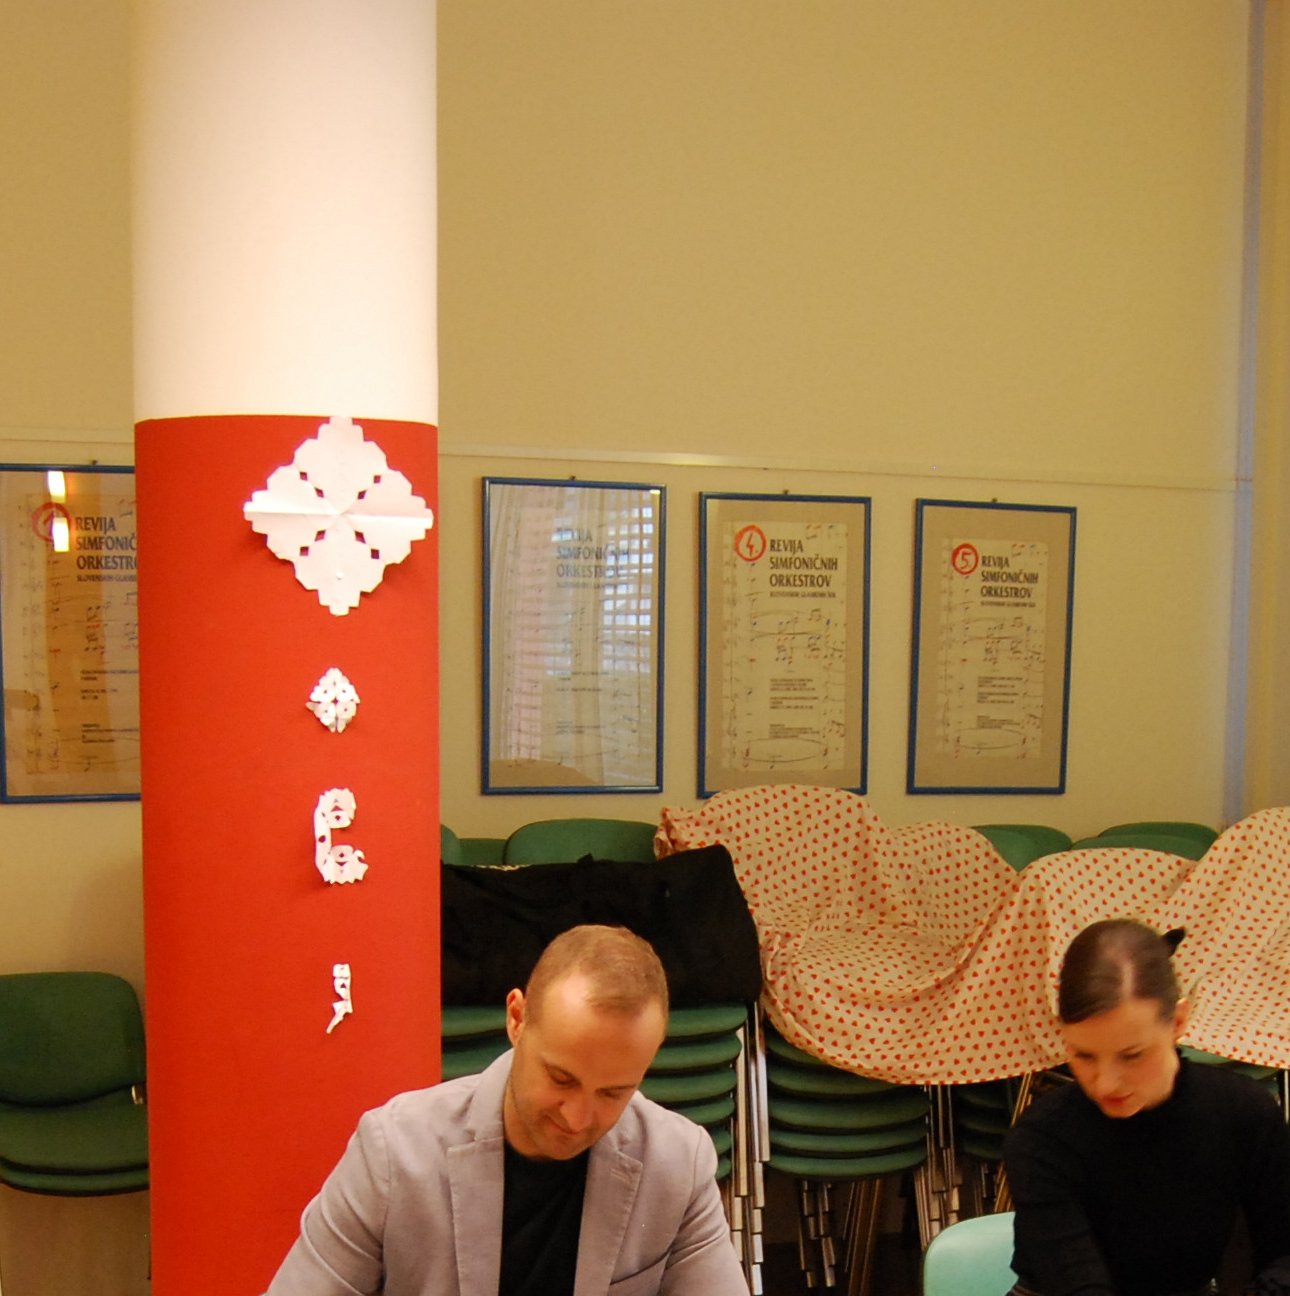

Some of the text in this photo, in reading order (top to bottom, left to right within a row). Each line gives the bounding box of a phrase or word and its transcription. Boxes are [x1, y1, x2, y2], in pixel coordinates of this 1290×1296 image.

[76, 517, 117, 535] REVIJA
[770, 539, 804, 555] REVIJA
[77, 556, 137, 570] ORKESTR
[770, 554, 838, 571] SIMFONIČNIH
[981, 556, 1009, 569] REVIJA
[770, 574, 832, 588] ORKESTROV
[981, 569, 1038, 584] SIMFONIČNIH
[980, 586, 1032, 598] ORKESTROV
